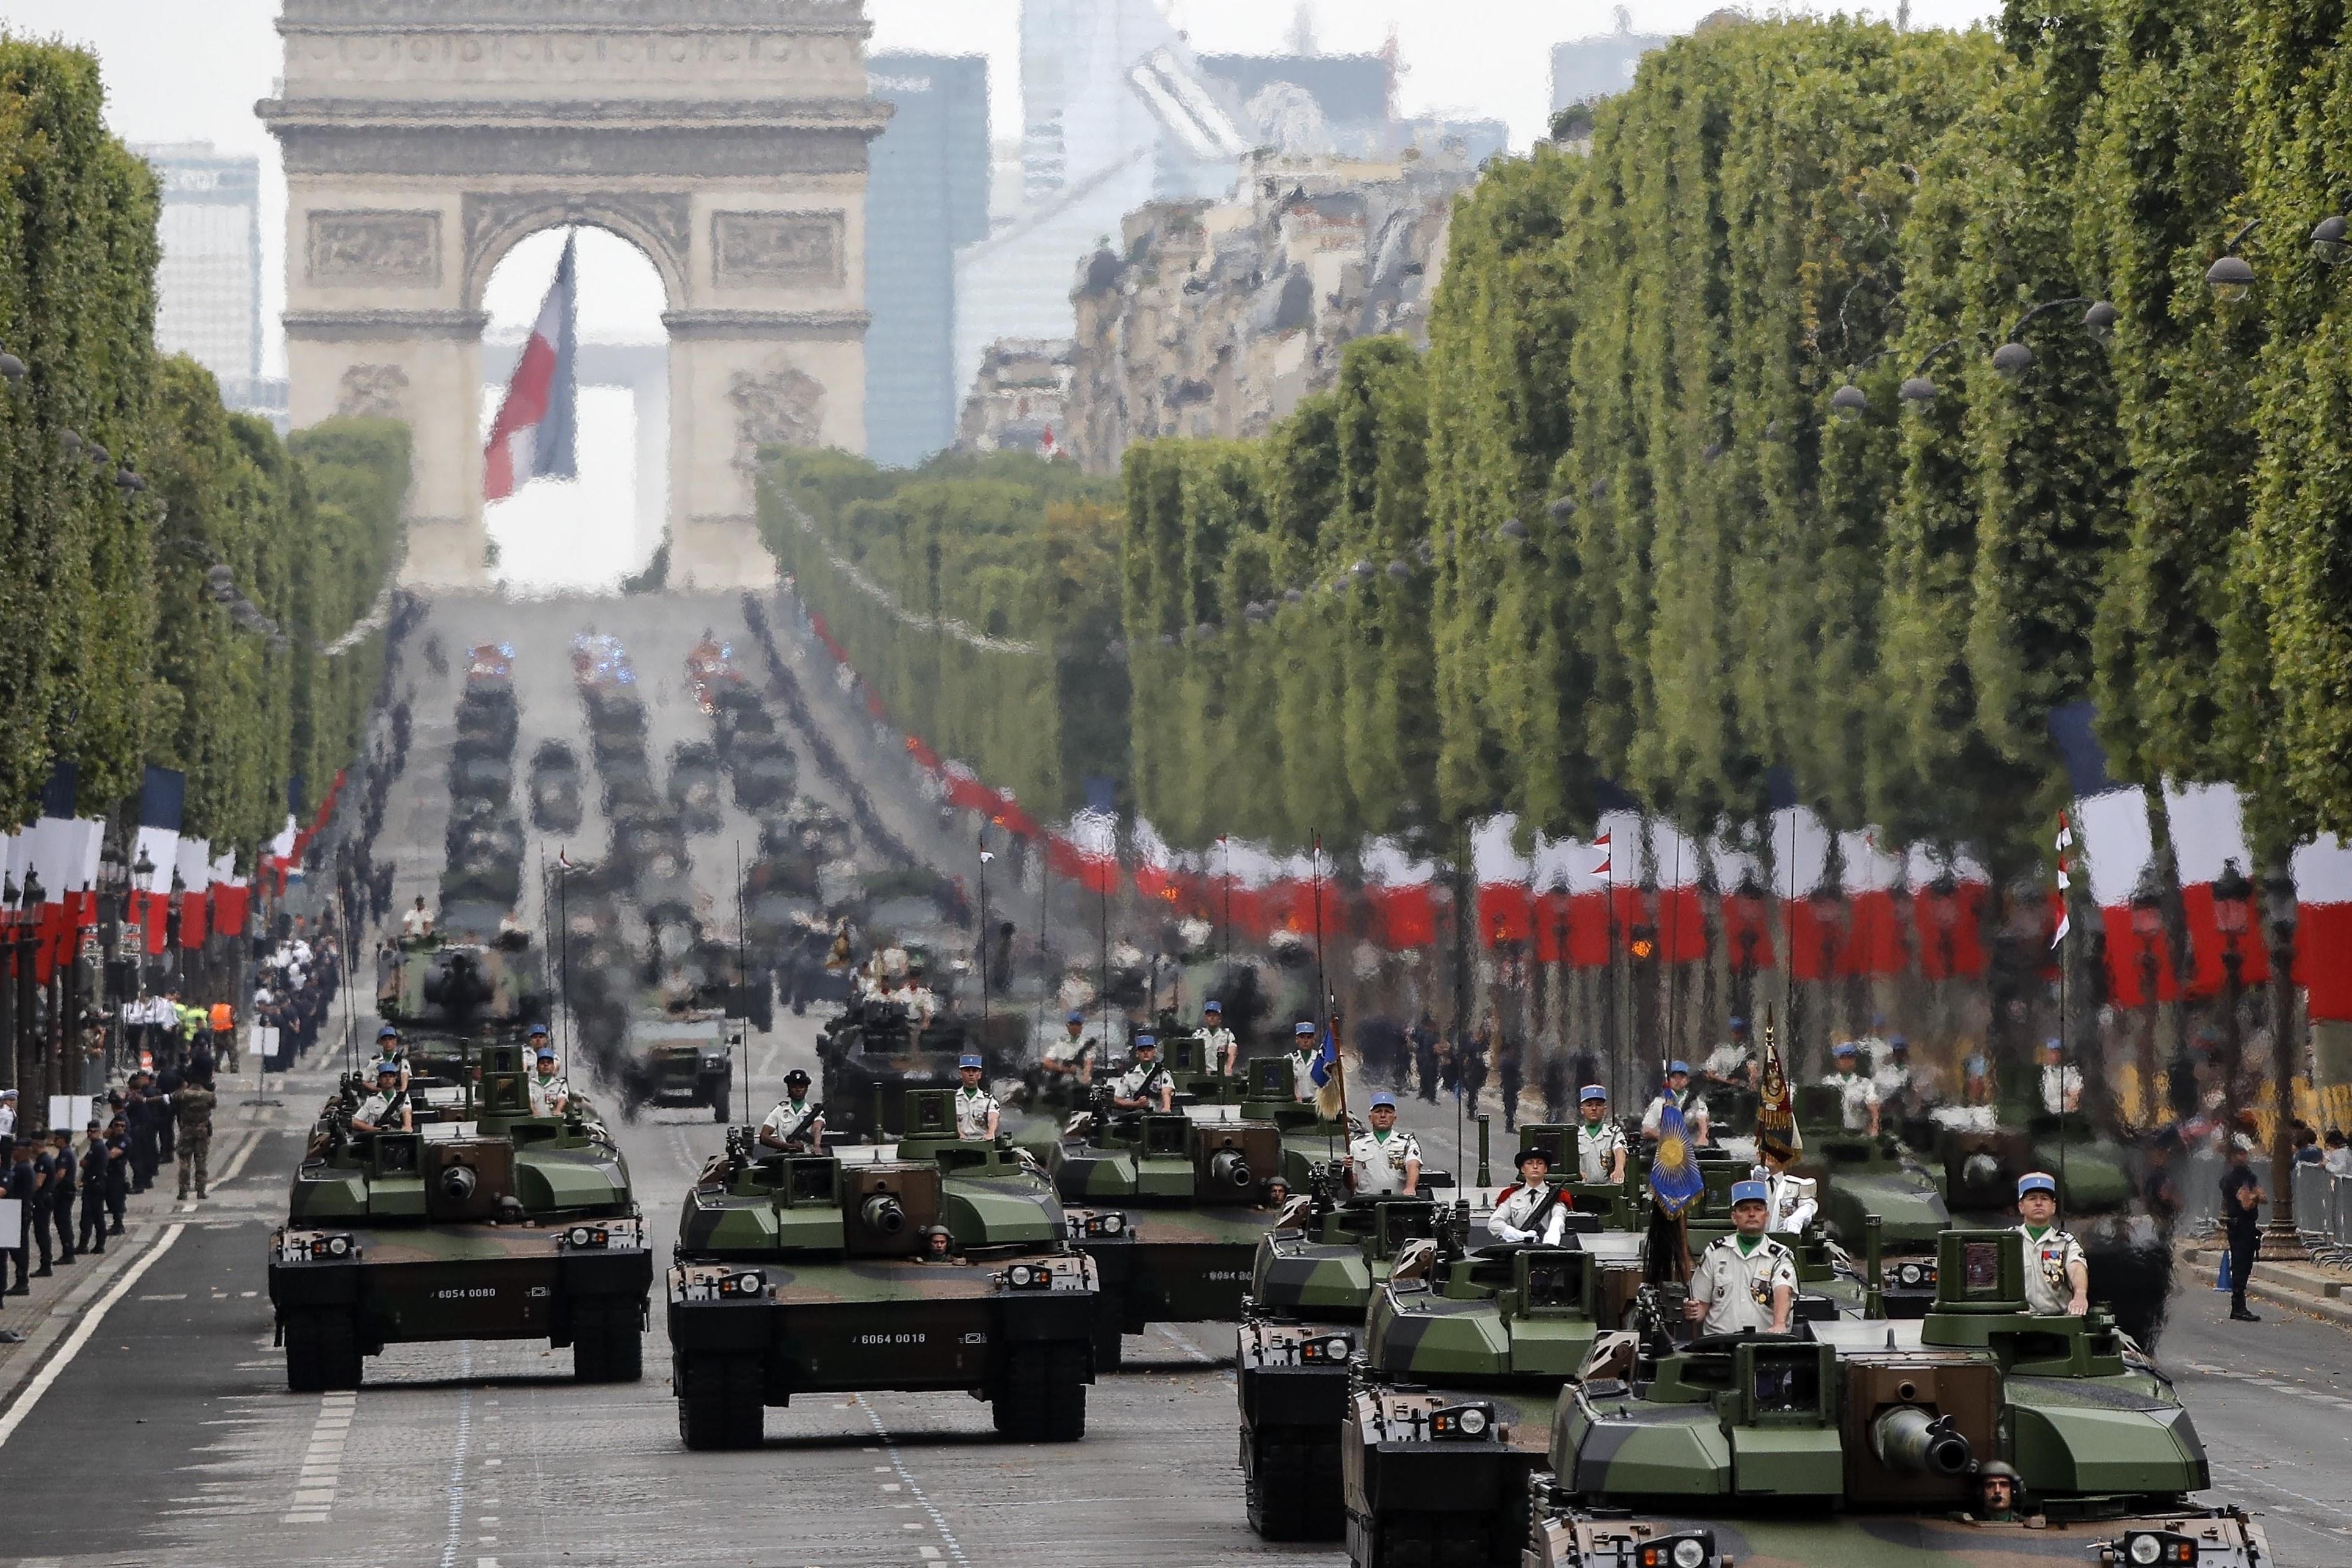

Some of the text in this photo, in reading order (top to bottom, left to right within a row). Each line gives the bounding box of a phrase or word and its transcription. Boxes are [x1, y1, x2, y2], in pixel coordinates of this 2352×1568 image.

[438, 1290, 465, 1298] 6054
[862, 1334, 926, 1344] 6064 0018
